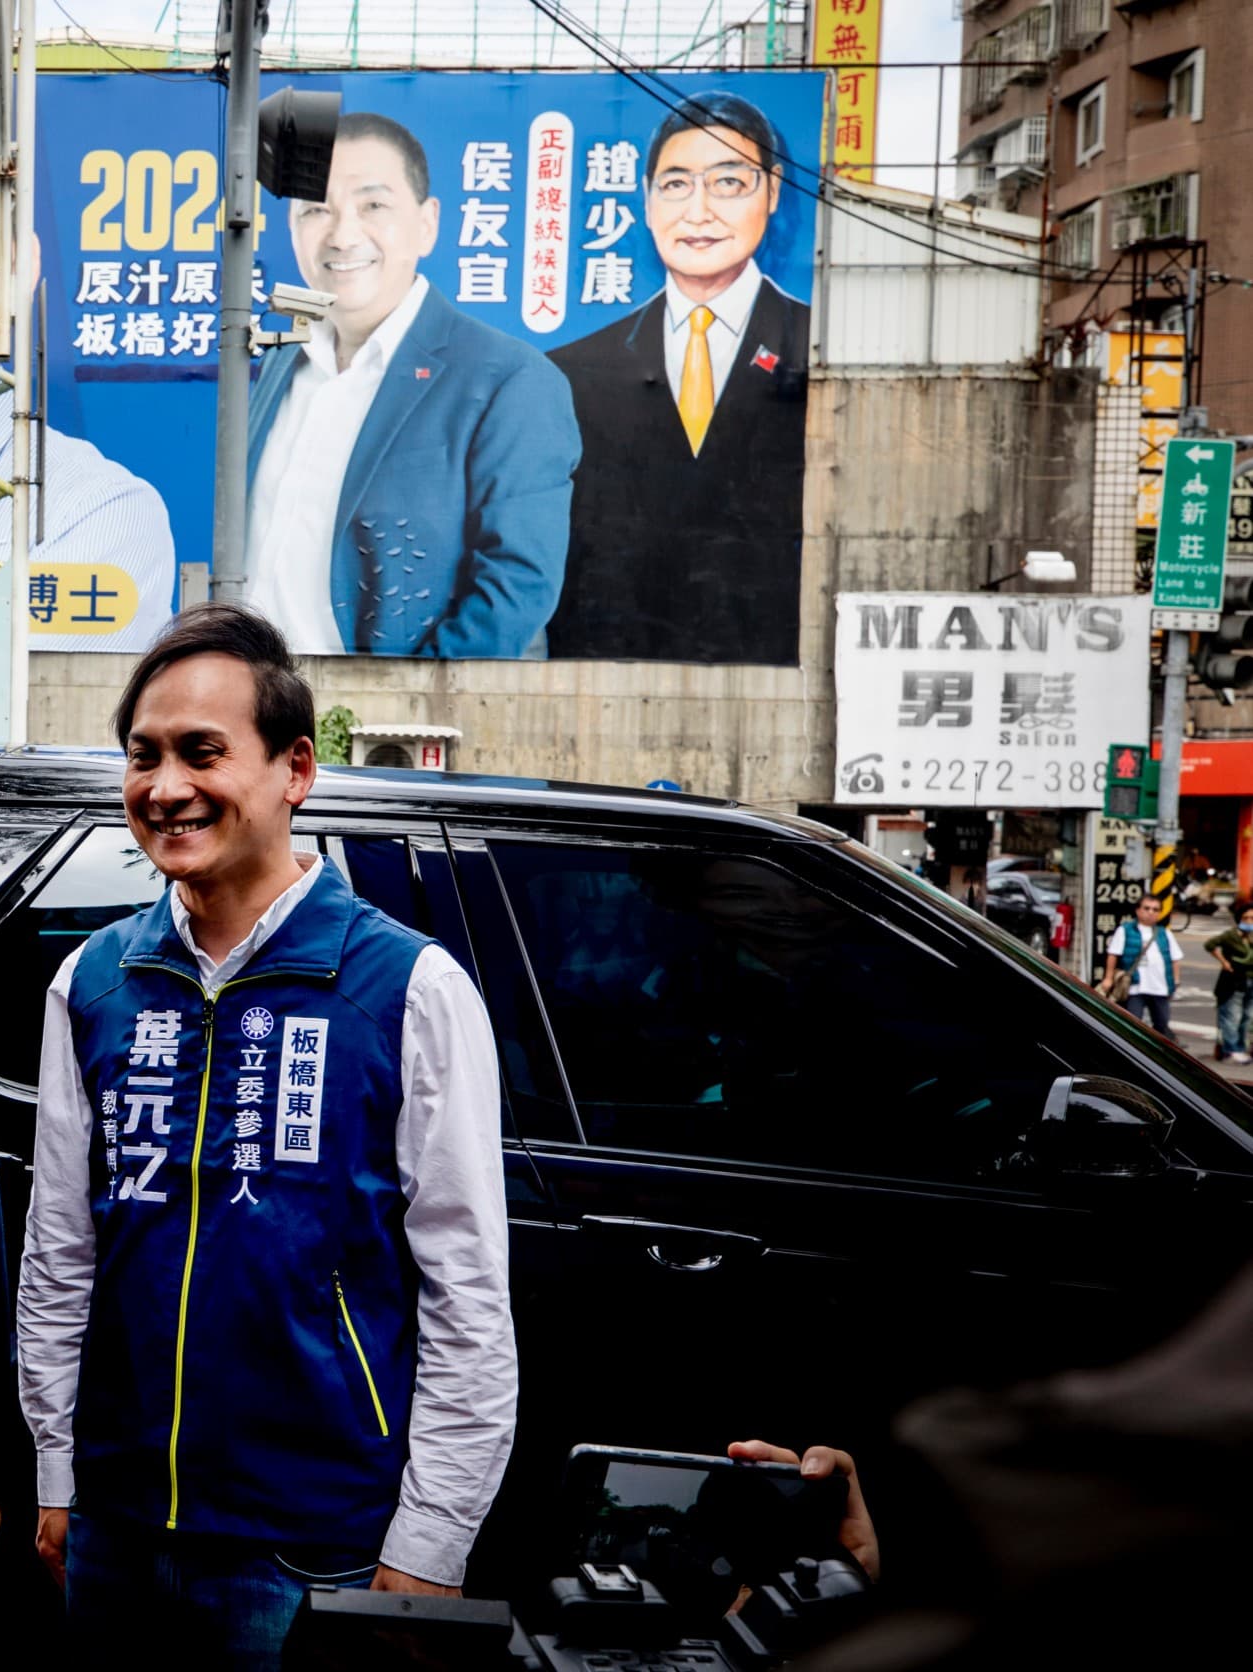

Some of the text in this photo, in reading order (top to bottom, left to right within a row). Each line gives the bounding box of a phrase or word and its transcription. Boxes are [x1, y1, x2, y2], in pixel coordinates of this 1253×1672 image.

[456, 141, 512, 303] 侯友宜
[530, 129, 567, 316] 正副總統候選人
[580, 141, 640, 304] 趙少康
[73, 312, 265, 357] 板橋好
[1178, 500, 1207, 559] 新莊
[1158, 577, 1206, 590] Lane to
[1159, 561, 1220, 576] Motorcycle
[855, 600, 1126, 652] MAN'S
[898, 671, 1076, 729] 男髮
[999, 731, 1076, 747] Salon
[1096, 883, 1143, 904] 249
[118, 1009, 182, 1203] 葉元之
[284, 1027, 320, 1152] 板橋東區
[230, 1044, 267, 1205] 立委參選人
